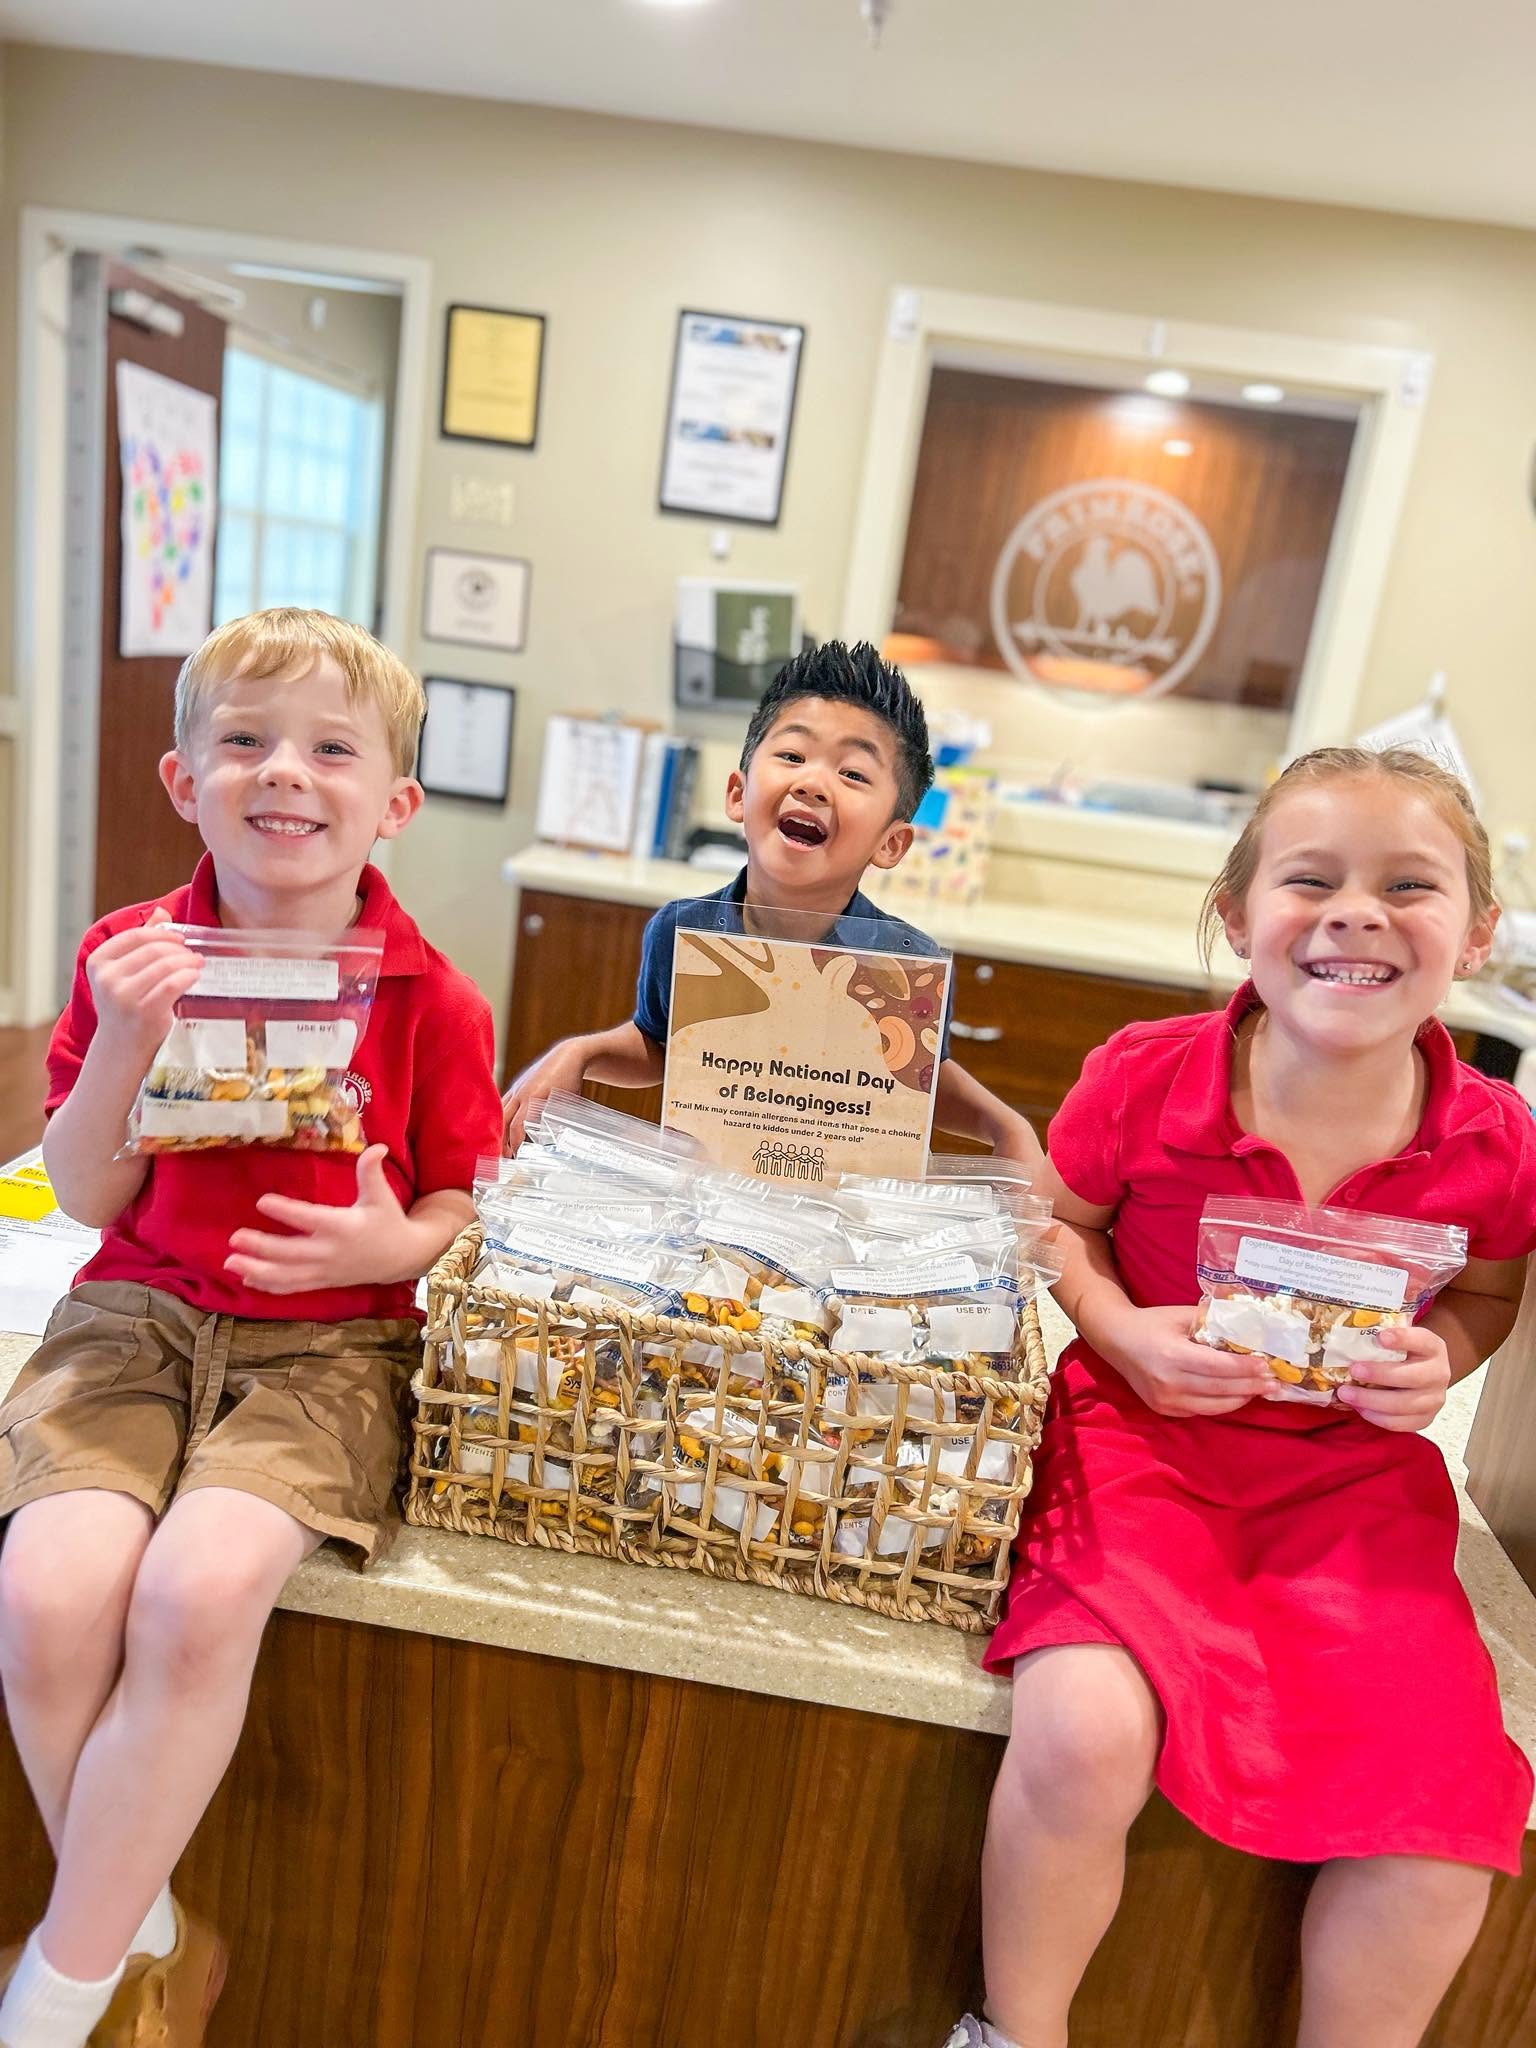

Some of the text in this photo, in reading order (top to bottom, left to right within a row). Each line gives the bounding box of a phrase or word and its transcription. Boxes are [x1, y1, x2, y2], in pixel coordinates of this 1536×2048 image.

[701, 1051, 895, 1094] Happy National Day
[719, 1084, 871, 1116] of Belongingess!
[694, 1103, 709, 1112] Mix
[711, 1106, 728, 1116] may
[729, 1108, 760, 1119] contain
[761, 1112, 798, 1124] allergens
[800, 1117, 815, 1126] and
[817, 1119, 840, 1129] items
[841, 1122, 858, 1131] that
[859, 1124, 880, 1134] pose
[888, 1128, 921, 1140] choking
[723, 1118, 751, 1129] hazard
[752, 1122, 761, 1130] to
[762, 1123, 789, 1134] kiddos
[791, 1128, 815, 1138] under
[816, 1130, 822, 1138] 2
[823, 1132, 847, 1142] years
[850, 1306, 877, 1315] DATE:
[956, 1306, 991, 1314] USE BY:
[1360, 1328, 1378, 1336] USE
[951, 1436, 970, 1446] USE
[460, 1445, 496, 1458] ONTENTS
